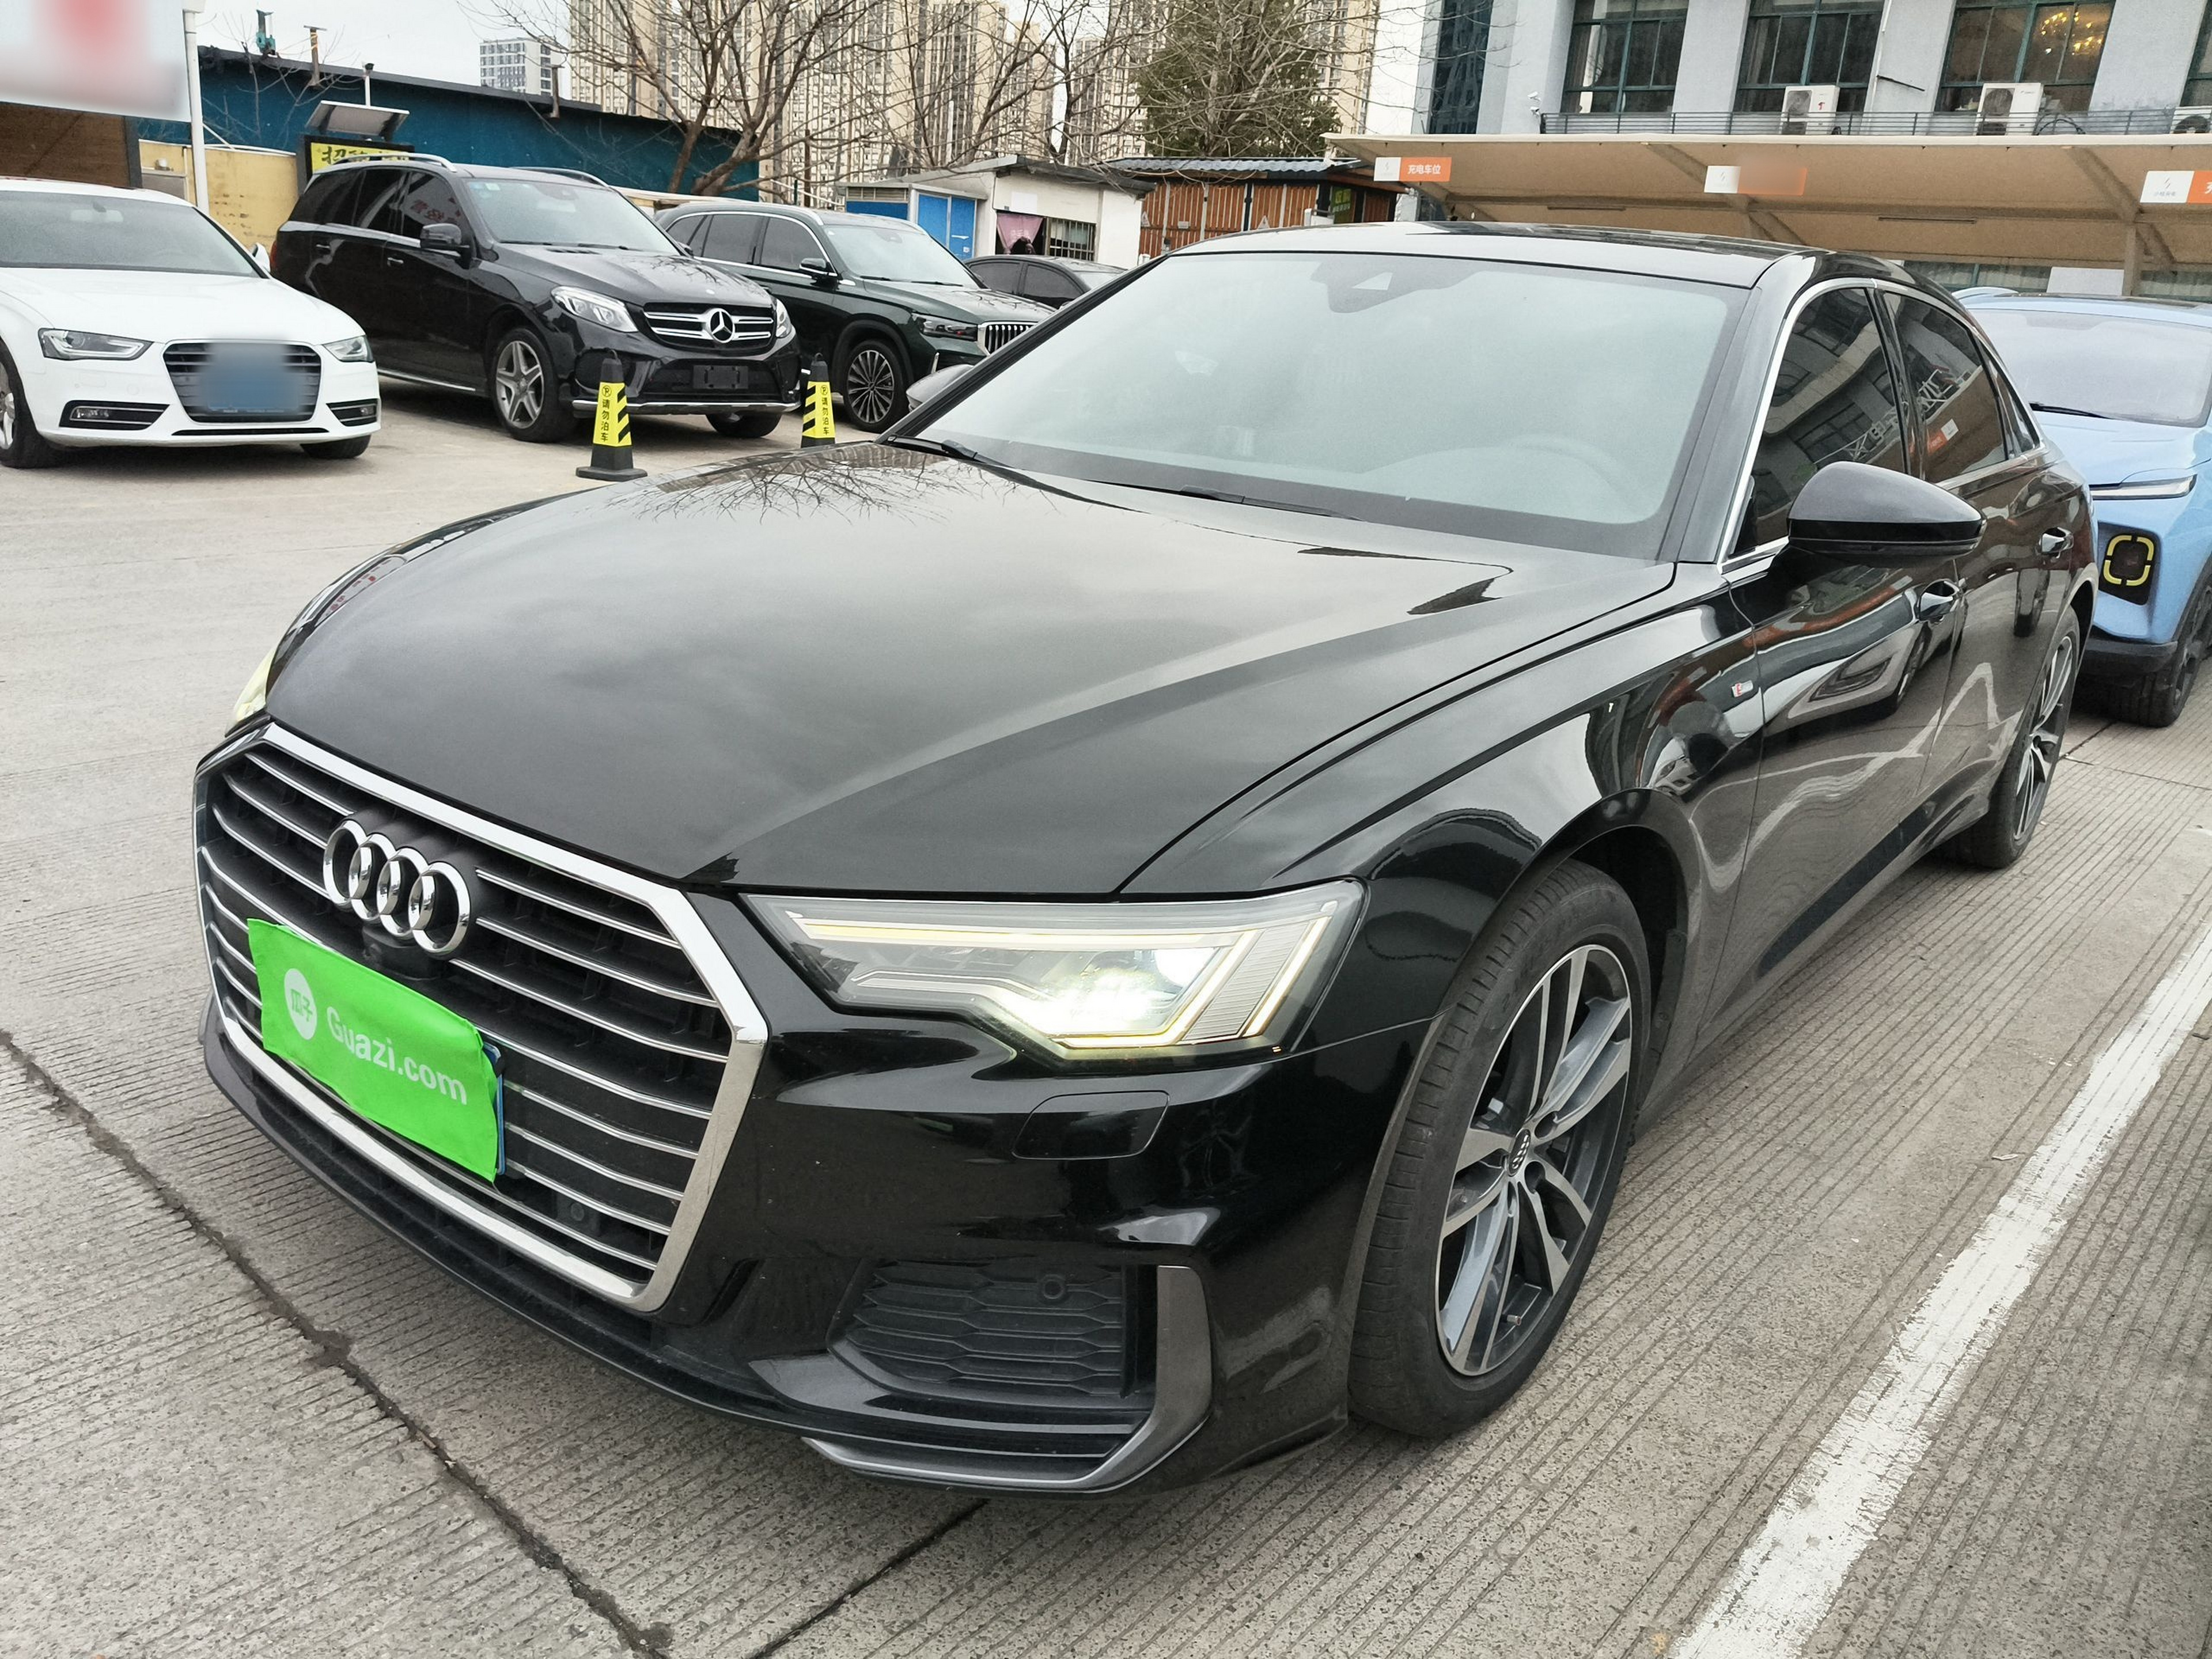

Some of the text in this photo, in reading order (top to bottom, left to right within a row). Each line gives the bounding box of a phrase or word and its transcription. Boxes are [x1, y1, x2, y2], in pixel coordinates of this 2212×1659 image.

[1407, 164, 1441, 175] 充电车位
[600, 399, 611, 442] 请勿泊车
[327, 1006, 467, 1105] Guazi.com
